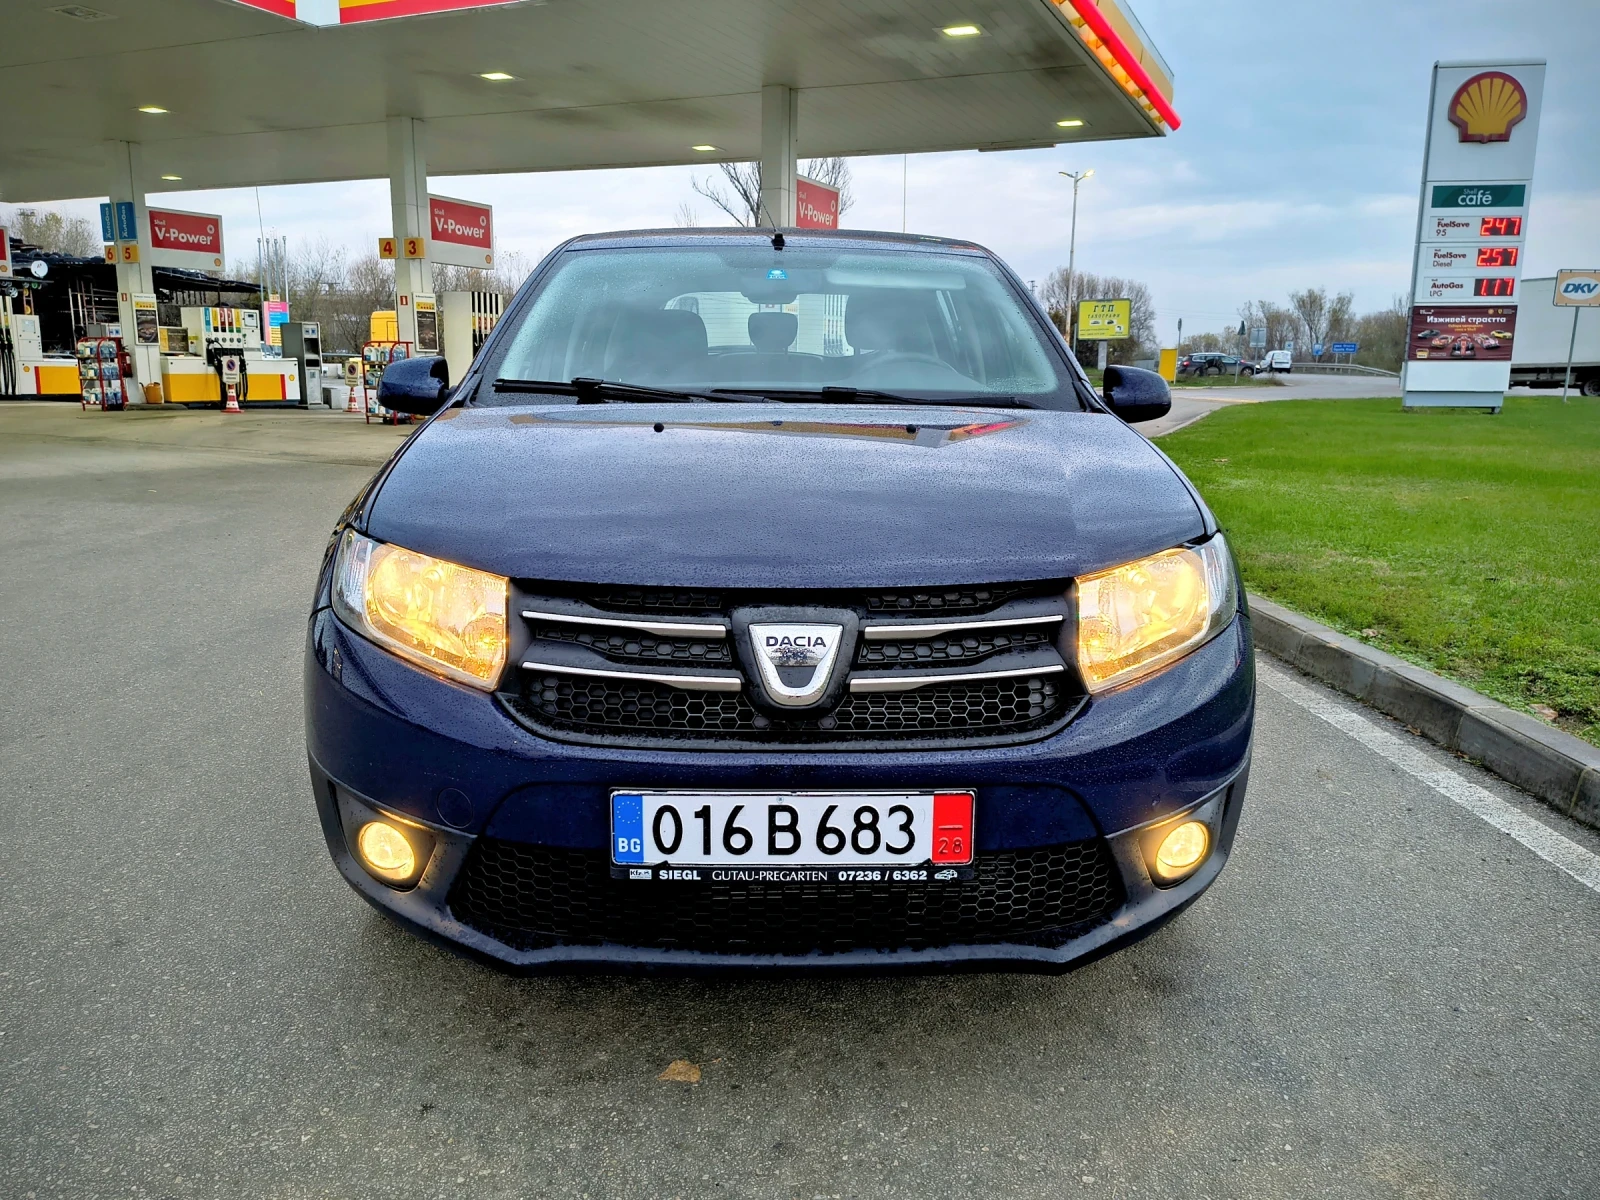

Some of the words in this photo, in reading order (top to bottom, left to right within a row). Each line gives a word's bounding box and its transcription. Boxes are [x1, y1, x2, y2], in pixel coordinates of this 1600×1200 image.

[1457, 190, 1492, 205] café
[798, 200, 834, 226] V-Power
[434, 216, 485, 239] V-Power
[154, 226, 213, 245] V-Power
[107, 247, 114, 260] 6
[124, 247, 131, 260] 5
[383, 241, 393, 255] 4
[408, 240, 417, 255] 3
[1477, 247, 1518, 267] 2.57
[1480, 278, 1514, 296] 1.17
[1562, 283, 1599, 293] DKV
[1426, 315, 1466, 323] Изживей
[765, 636, 827, 648] DACIA
[652, 804, 753, 855] 016
[768, 804, 802, 856] B
[815, 804, 916, 855] 683
[618, 837, 641, 853] BG
[937, 836, 964, 854] 28
[659, 869, 702, 881] SIEGL
[711, 870, 828, 881] GUTAU-PREGARTEN
[838, 870, 882, 881] 07236
[892, 870, 928, 881] 6362
